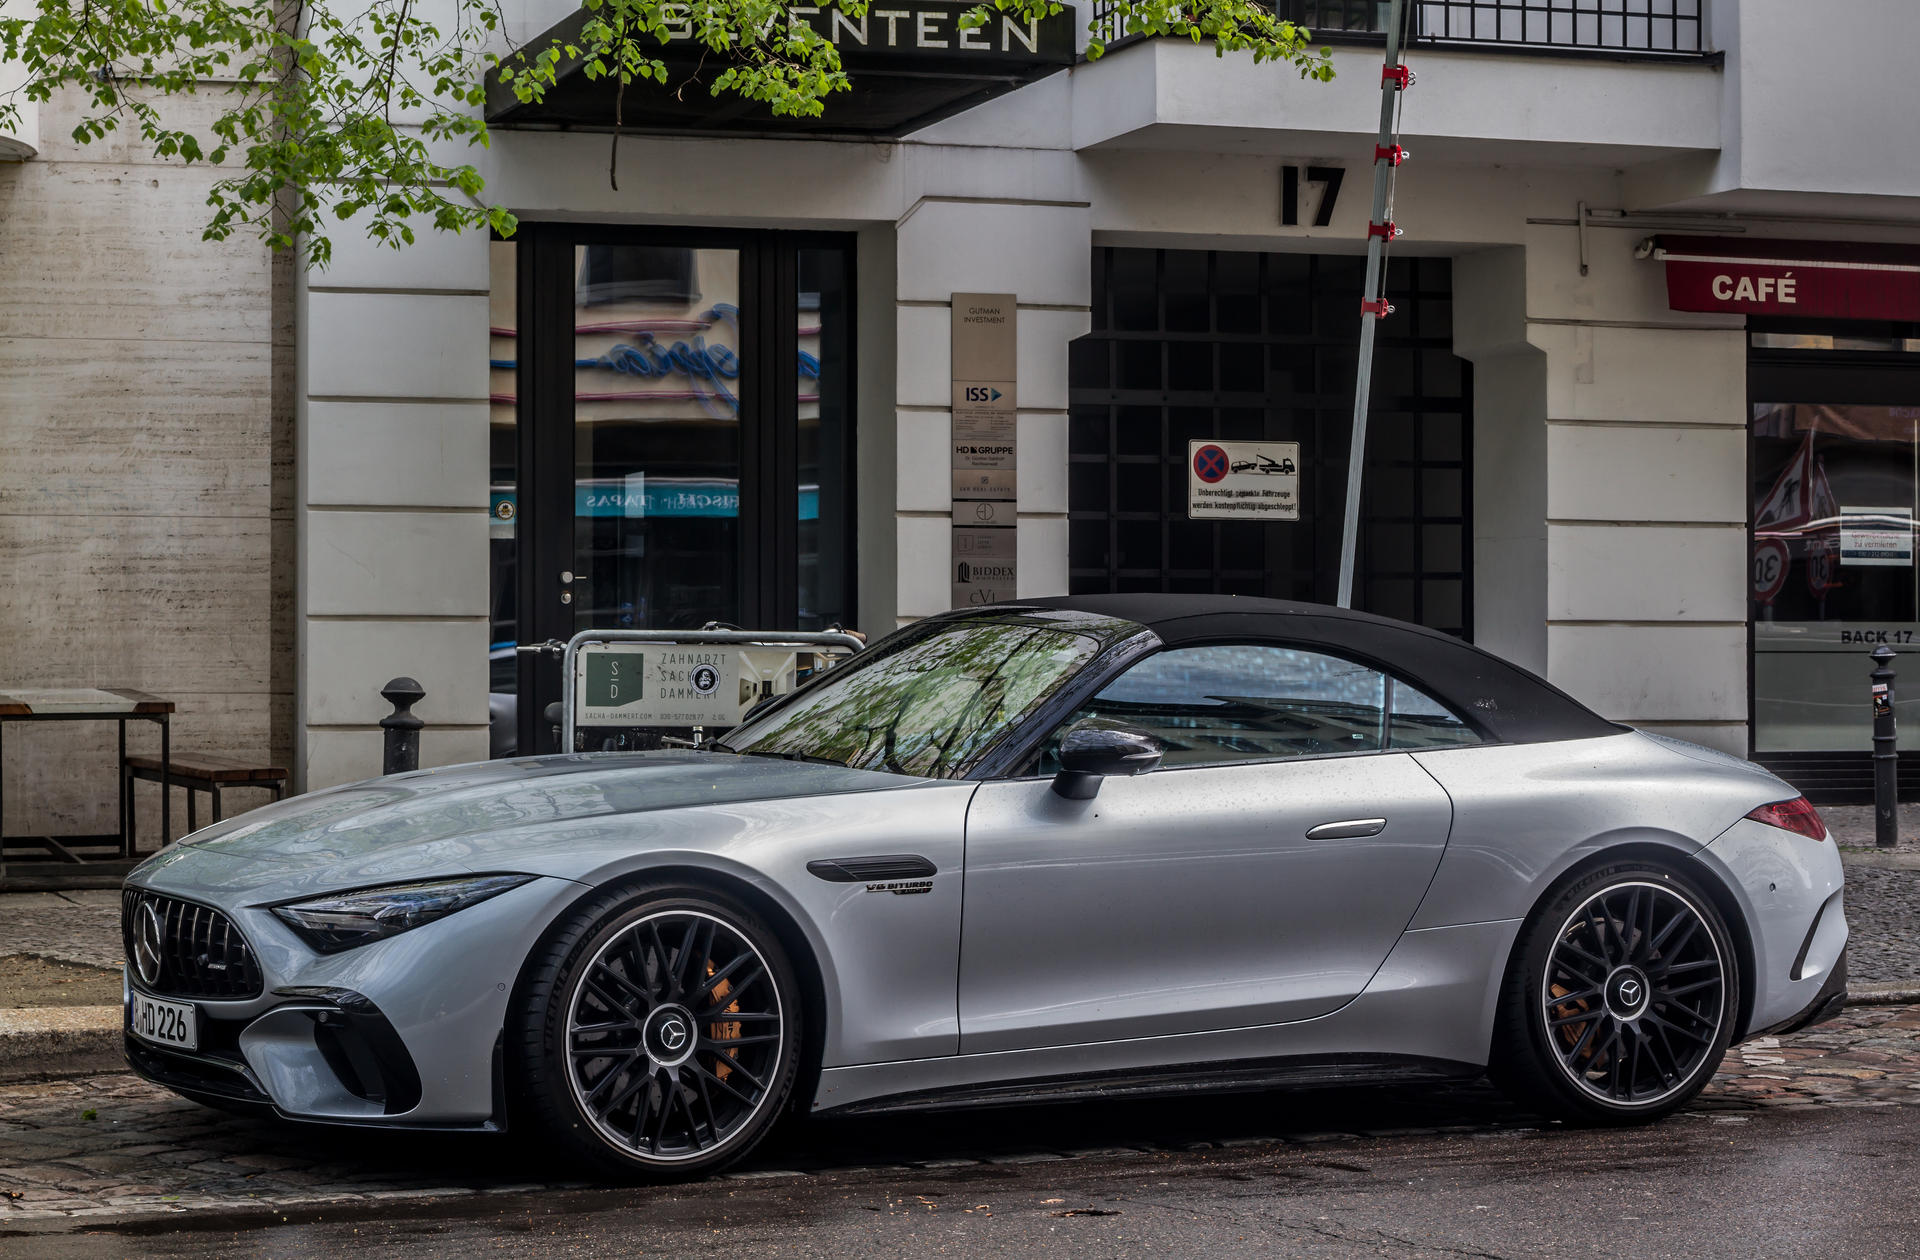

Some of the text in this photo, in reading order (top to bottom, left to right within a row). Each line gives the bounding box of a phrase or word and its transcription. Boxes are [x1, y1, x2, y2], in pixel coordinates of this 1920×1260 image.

[1281, 166, 1346, 227] 17
[1711, 271, 1797, 304] CAFÉ
[968, 307, 1001, 315] GUTMAN
[963, 316, 1006, 324] INVESTMENT
[965, 387, 989, 402] ISS
[956, 446, 1014, 455] HD GRUPPE
[1261, 489, 1291, 499] Fahrzeuge
[1192, 501, 1213, 509] werden
[1214, 501, 1256, 511] kostenpflichtig
[973, 567, 1014, 576] BIDDEX
[1841, 630, 1913, 644] BACK 17
[661, 652, 726, 665] ZAHNARZT
[611, 660, 619, 676] S
[660, 670, 692, 682] SACH
[610, 684, 619, 699] D
[887, 881, 934, 890] BITURBO
[142, 999, 155, 1036] HD
[158, 1005, 187, 1042] 226
